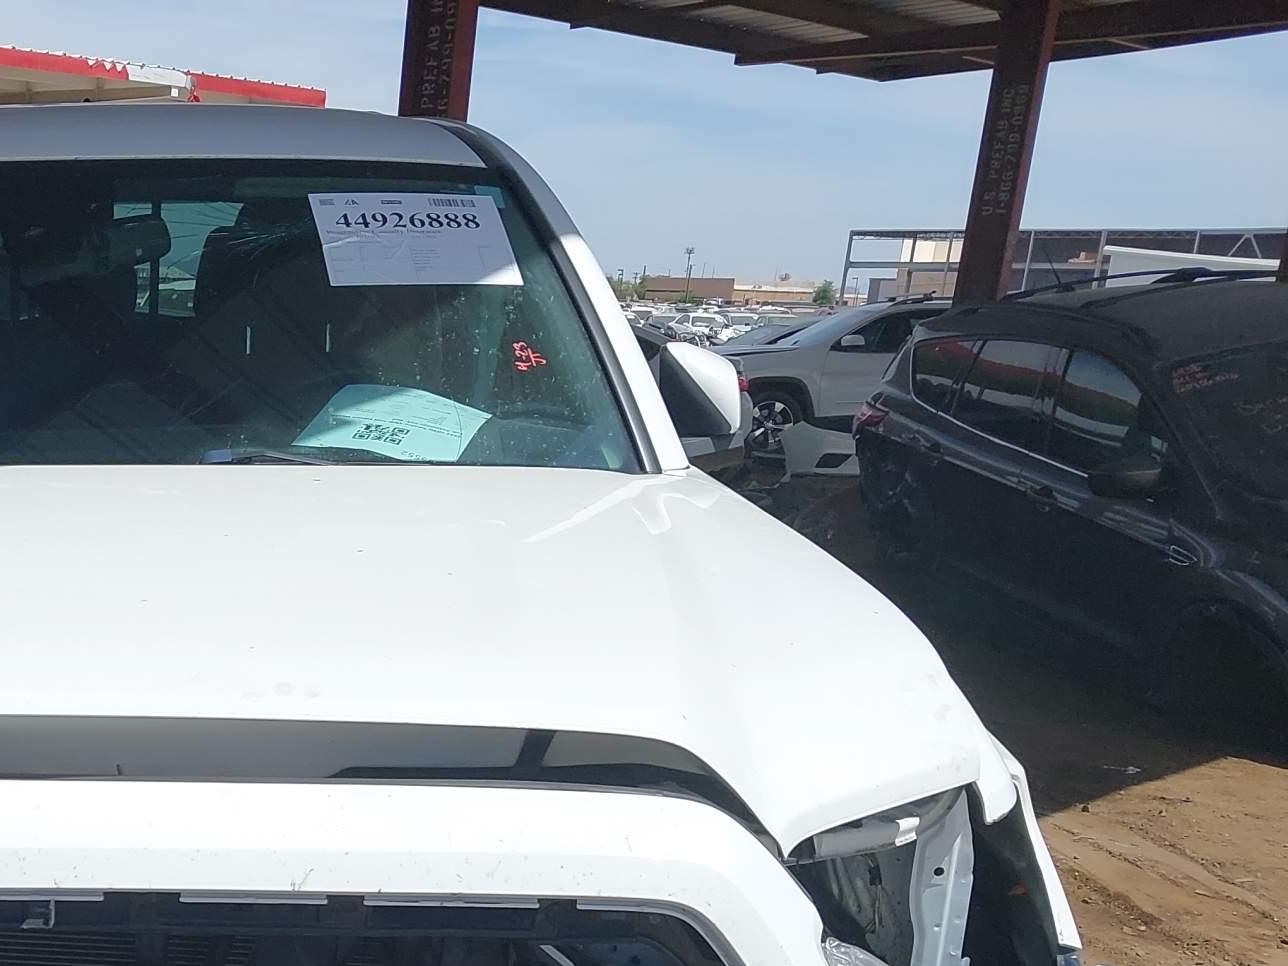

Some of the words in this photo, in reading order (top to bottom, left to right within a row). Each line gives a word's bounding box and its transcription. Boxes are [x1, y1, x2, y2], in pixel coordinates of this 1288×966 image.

[420, 25, 441, 109] PREFAB
[987, 120, 1009, 179] PREFAB
[335, 211, 481, 230] 44926888
